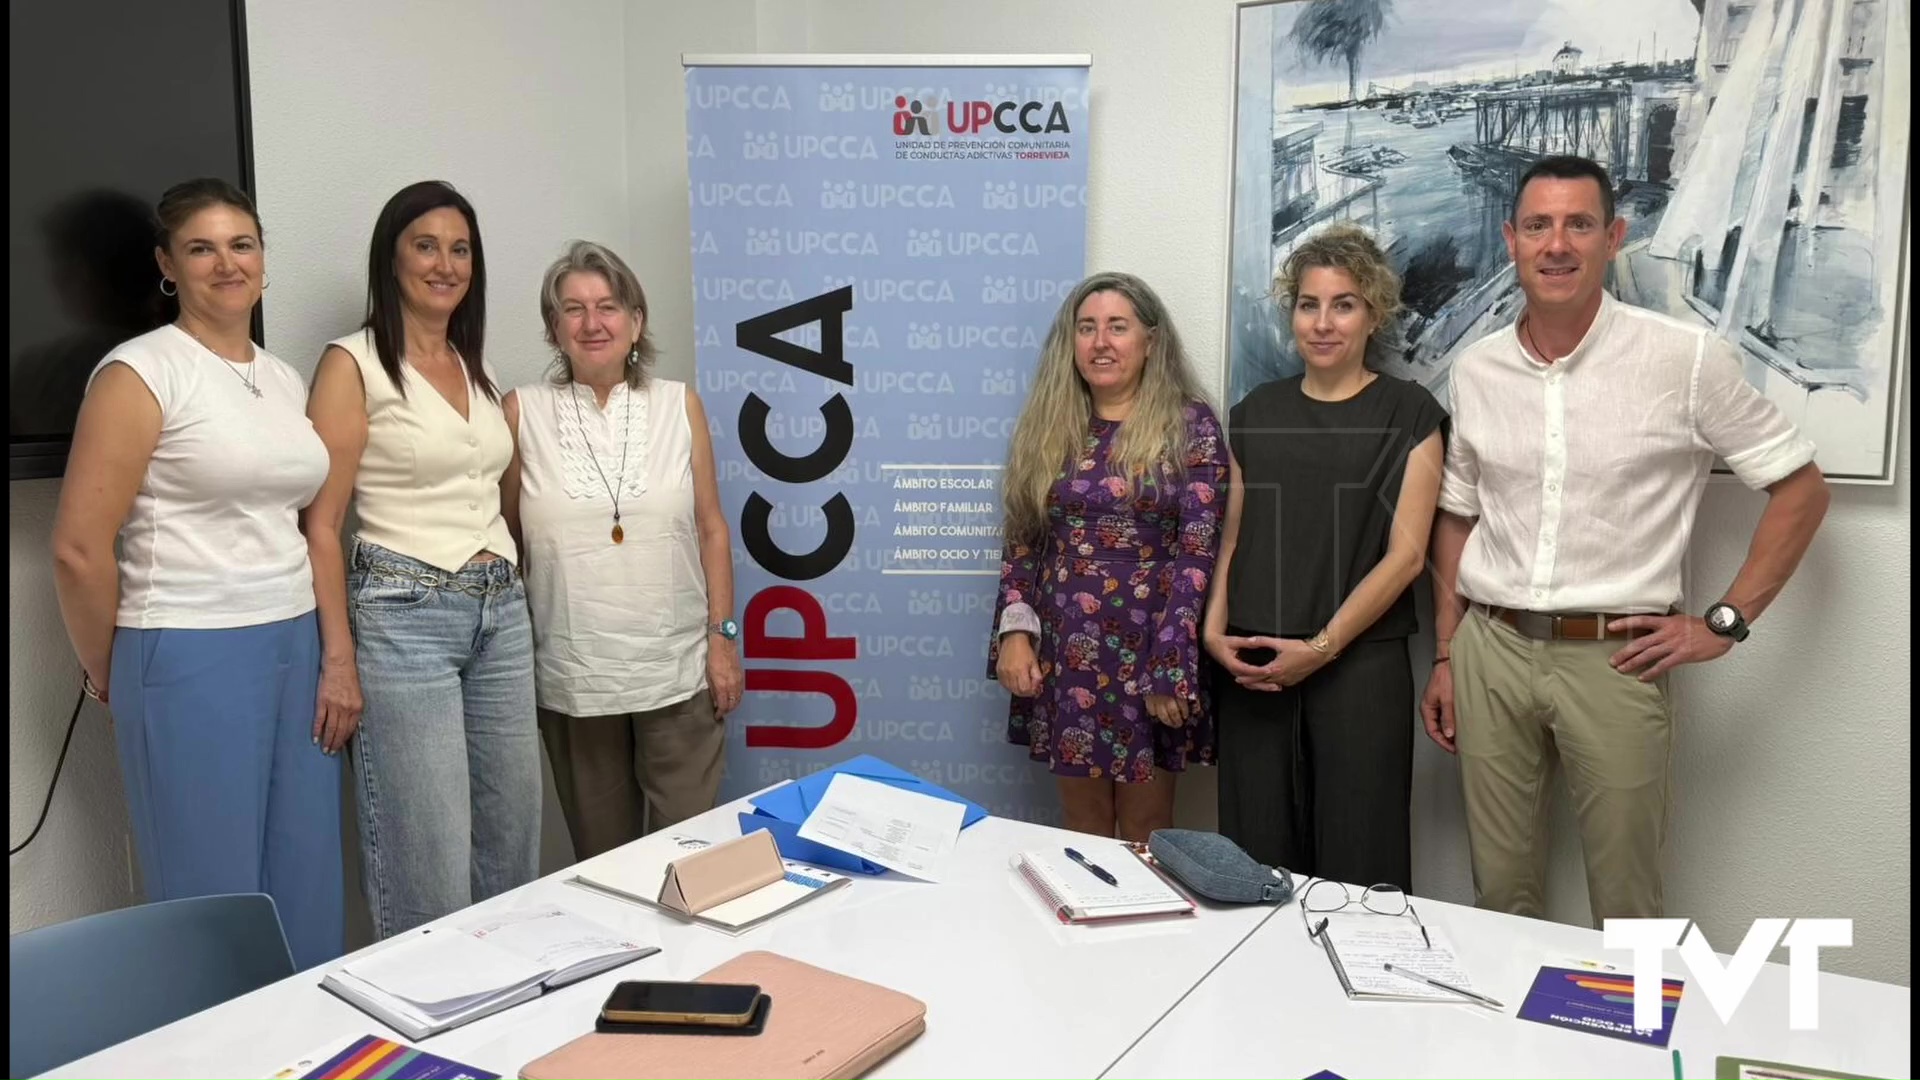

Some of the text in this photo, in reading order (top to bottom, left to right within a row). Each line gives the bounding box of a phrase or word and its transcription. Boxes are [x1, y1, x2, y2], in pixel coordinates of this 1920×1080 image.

[695, 85, 792, 111] UPCCA
[946, 100, 1072, 134] UPCCA
[784, 135, 879, 160] UPCCA
[895, 141, 931, 149] UNIDAD
[933, 141, 946, 149] DE
[1008, 141, 1070, 149] COMUNITARIA
[895, 151, 1070, 160] DE CONDUCTAS ADICTIVAS TORREVIEJA
[700, 182, 794, 208] UPCCA
[862, 183, 955, 209] UPCCA
[786, 231, 880, 256] UPCCA
[947, 232, 1040, 256] UPCCA
[702, 278, 794, 302] UPCCA
[861, 279, 955, 303] UPCCA
[947, 326, 1040, 350] UPCCA
[706, 370, 798, 394] UPCCA
[863, 371, 955, 394] UPCCA
[893, 475, 994, 490] ÁMBITO ESCOLAR
[736, 284, 856, 748] UPCCA
[893, 498, 994, 513] ÁMBITO FAMILIAR
[893, 521, 937, 536] ÁMBITO
[893, 545, 1002, 560] ÁMBITO OCIO Y TIE
[866, 636, 954, 659] UPCCA
[866, 720, 954, 743] UPCCA
[947, 763, 1037, 785] UPCCA
